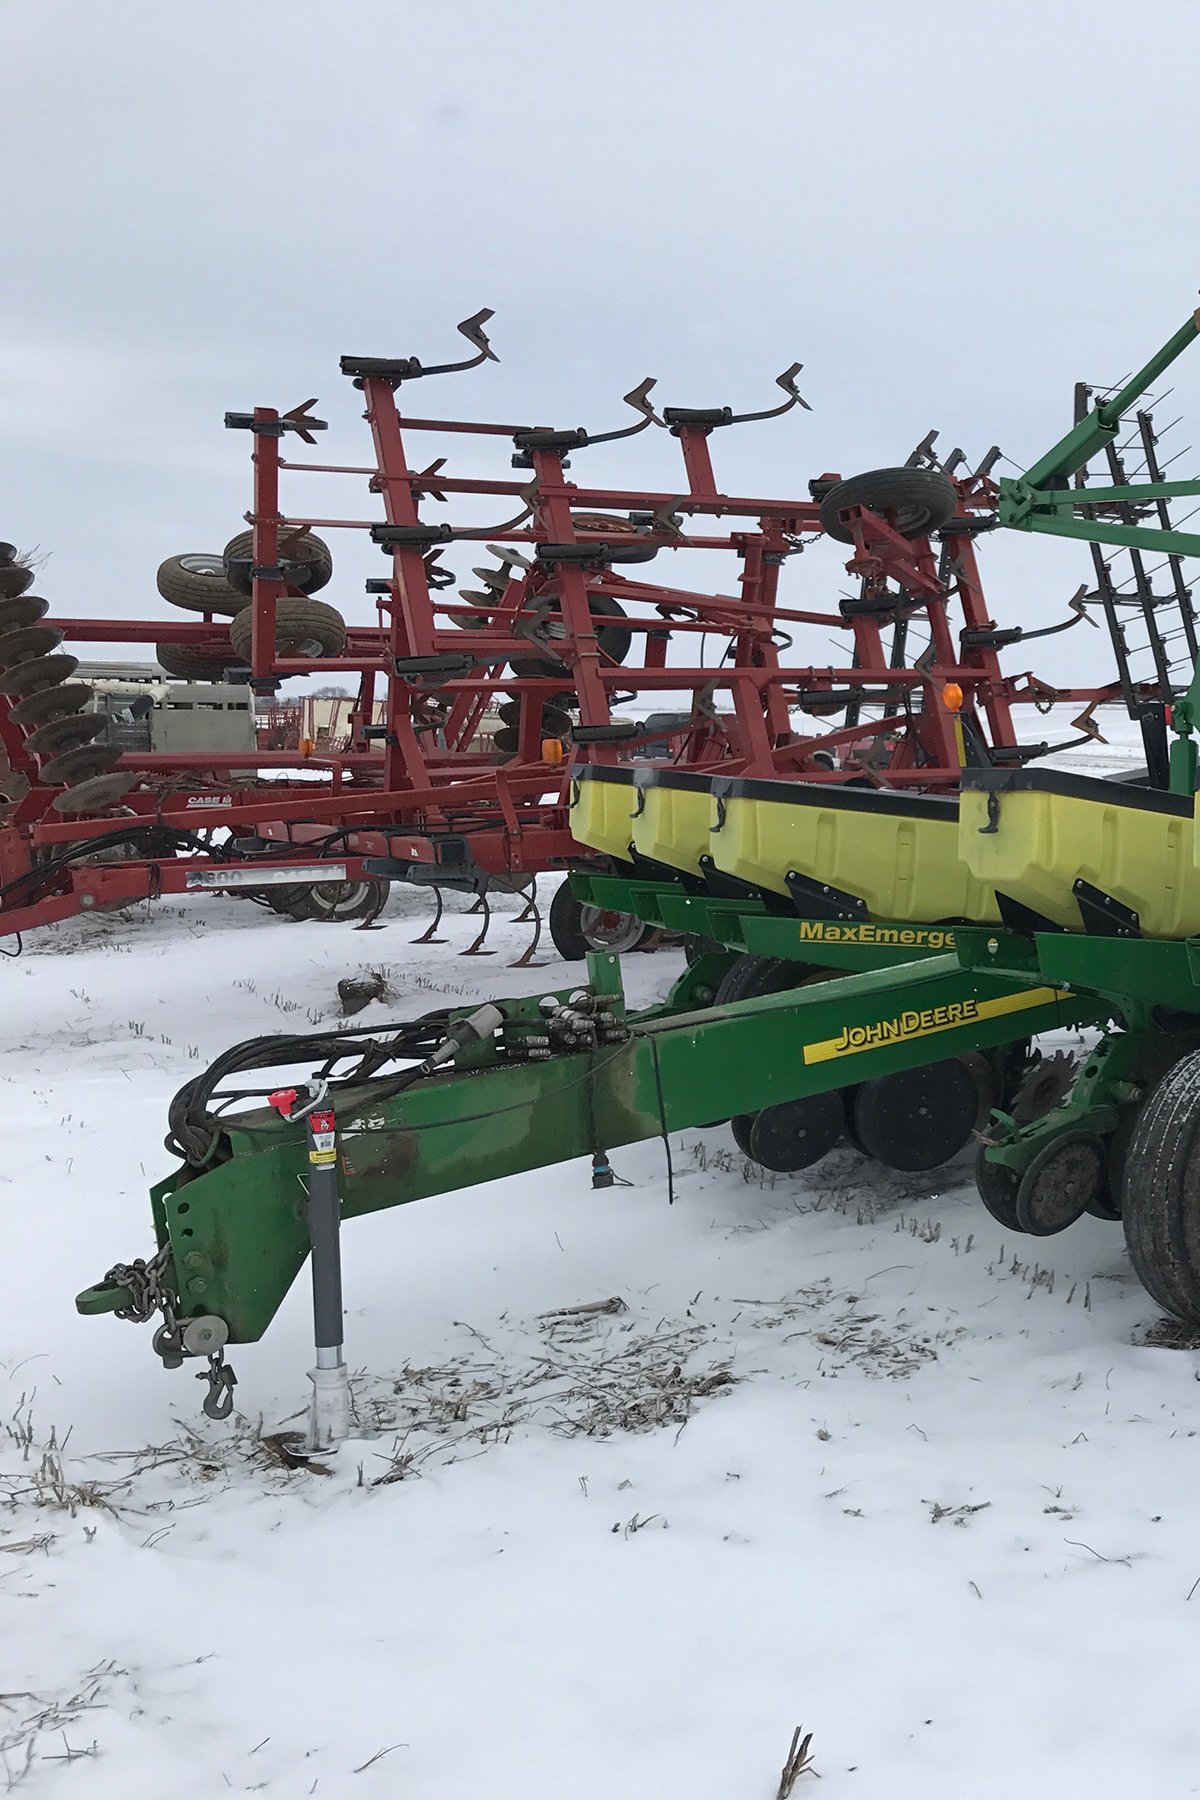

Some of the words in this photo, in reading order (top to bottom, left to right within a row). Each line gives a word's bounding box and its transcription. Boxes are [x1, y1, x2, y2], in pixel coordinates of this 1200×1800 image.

[188, 796, 220, 804] CASE
[800, 921, 956, 949] MaxEmerge
[835, 1018, 899, 1051] JOHN
[901, 999, 978, 1035] DEERE
